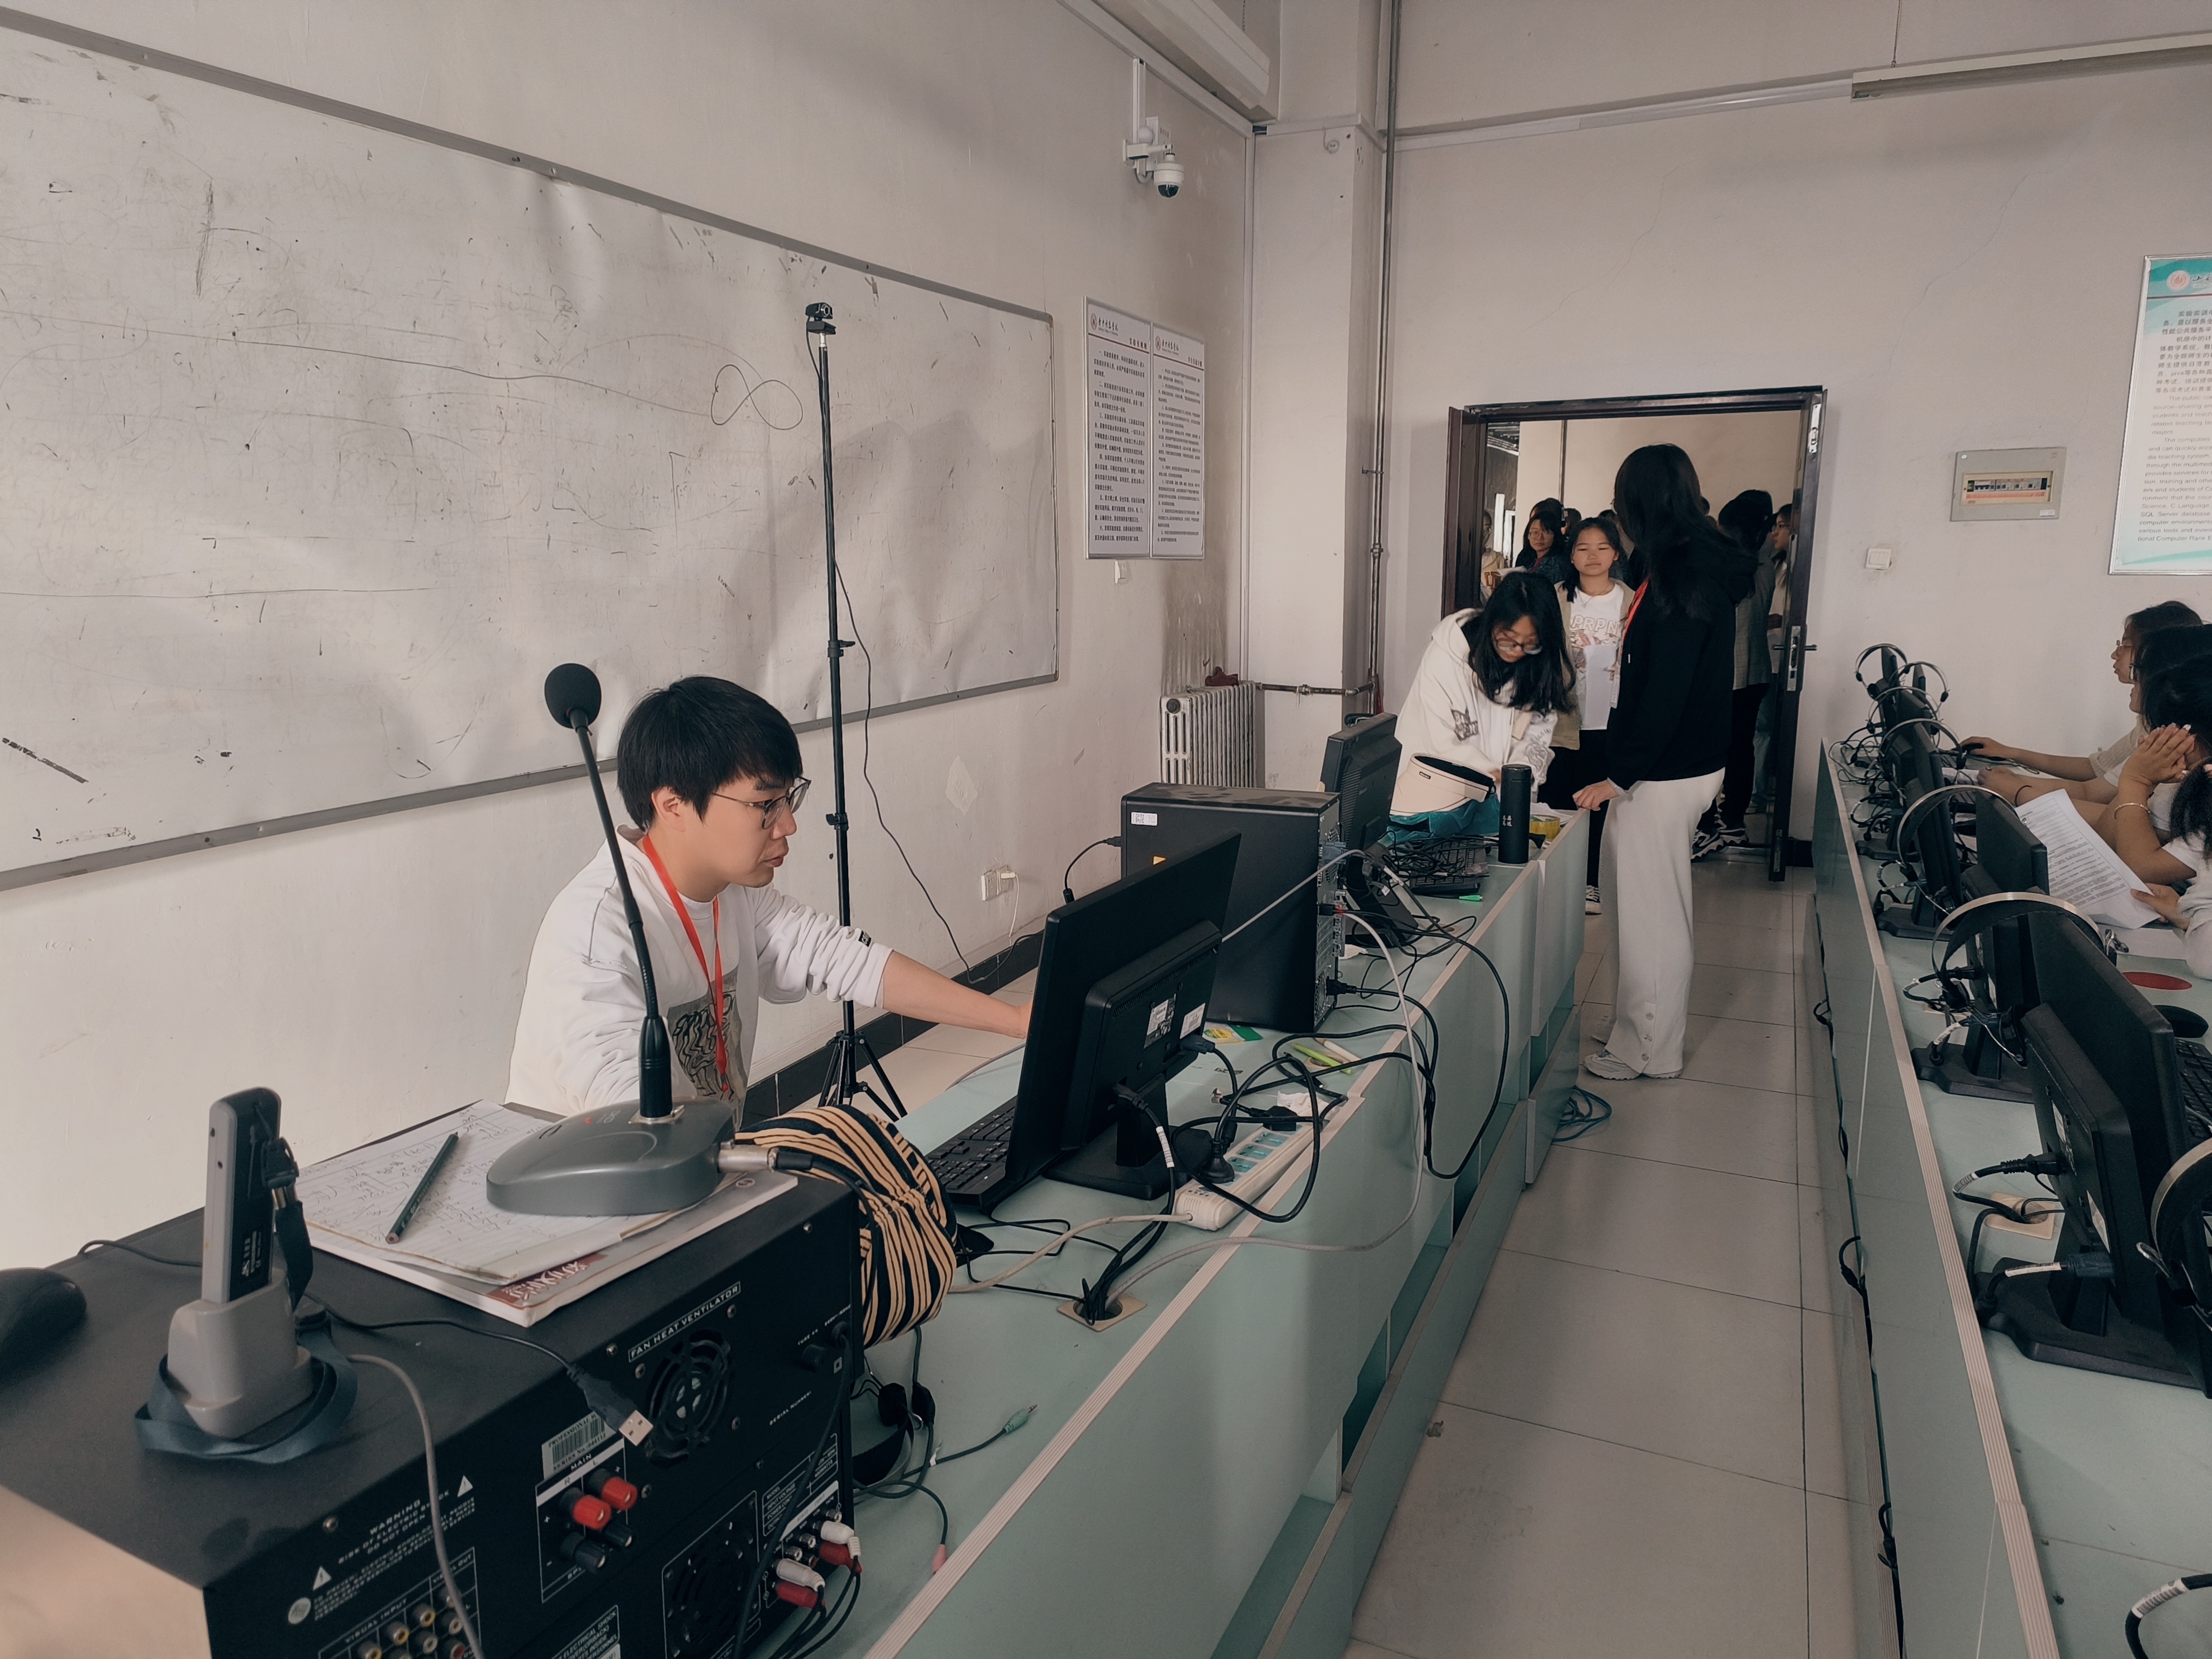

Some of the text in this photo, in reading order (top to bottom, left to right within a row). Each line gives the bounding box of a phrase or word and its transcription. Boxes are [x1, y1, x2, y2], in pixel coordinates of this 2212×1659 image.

[631, 1285, 738, 1358] FAN HEAT VENTILATOR
[571, 1453, 592, 1471] MAIN
[370, 1499, 421, 1534] WARNING
[368, 1514, 426, 1554] DO NOT OPEN
[339, 1547, 360, 1564] RISK
[458, 1554, 471, 1566] OUT
